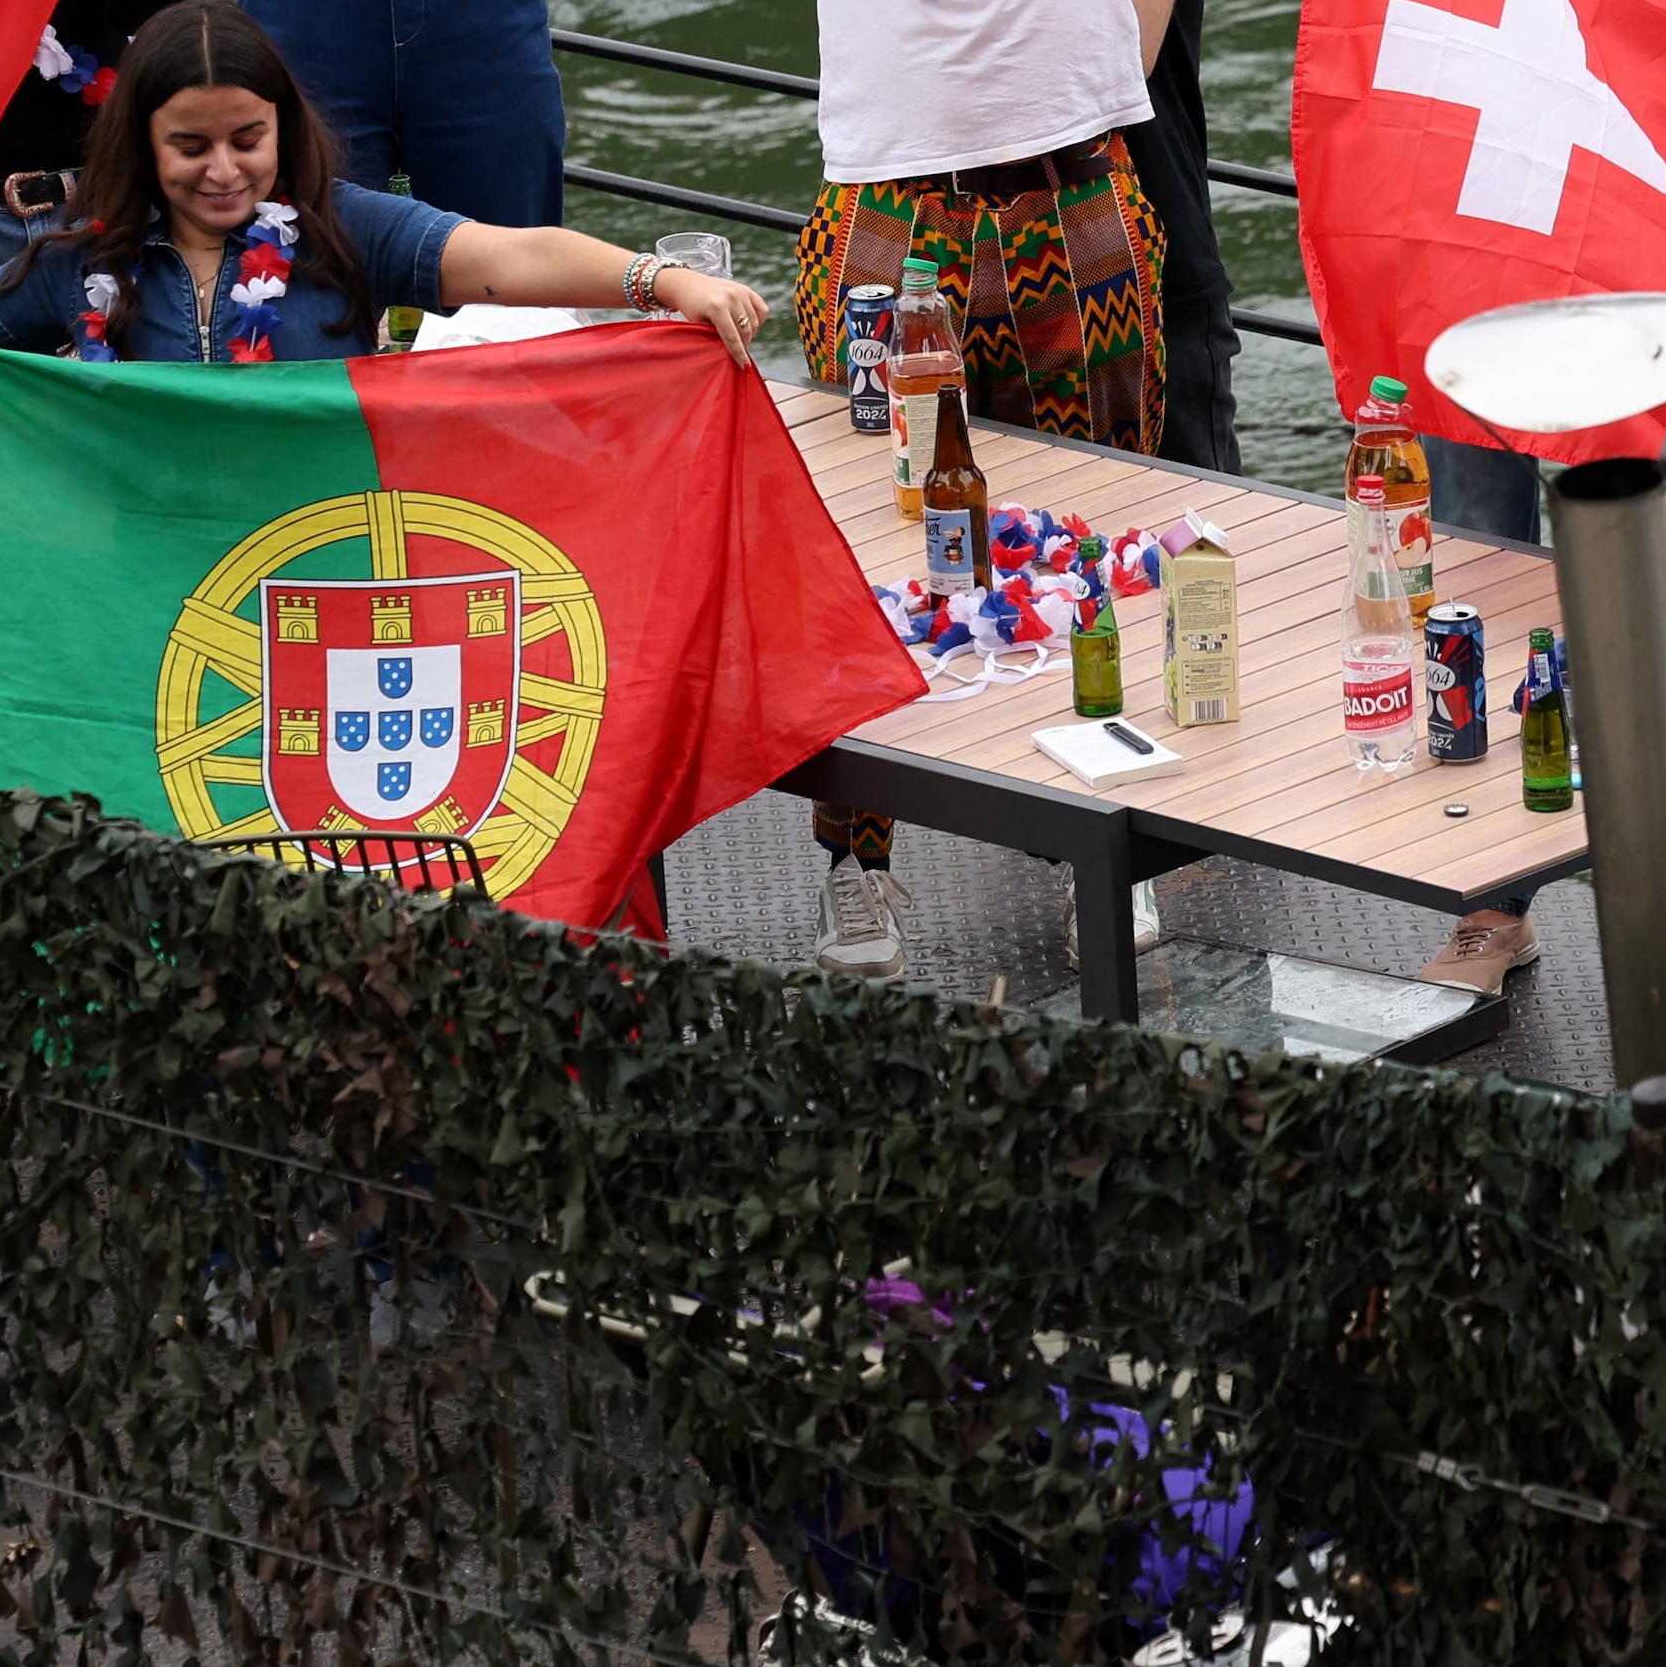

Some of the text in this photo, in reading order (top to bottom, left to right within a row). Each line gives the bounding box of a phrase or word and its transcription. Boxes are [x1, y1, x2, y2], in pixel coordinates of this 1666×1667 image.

[851, 343, 884, 362] 1664
[856, 409, 887, 421] 2024
[1344, 685, 1408, 716] BADOIT
